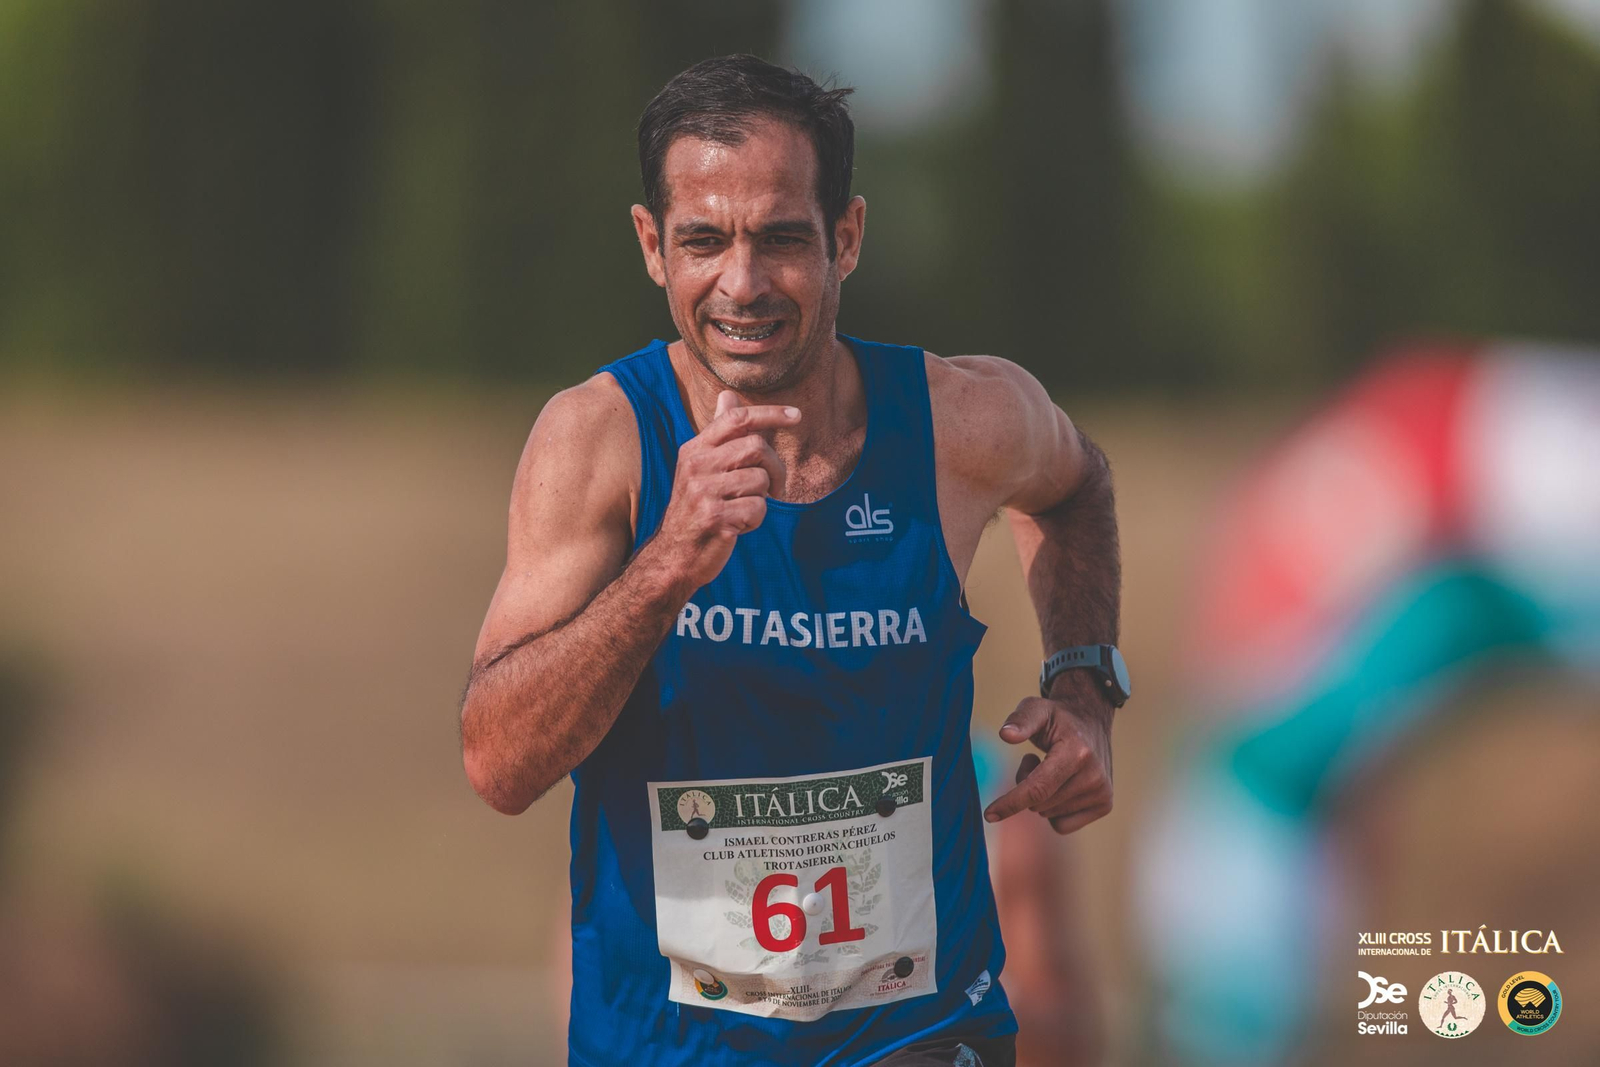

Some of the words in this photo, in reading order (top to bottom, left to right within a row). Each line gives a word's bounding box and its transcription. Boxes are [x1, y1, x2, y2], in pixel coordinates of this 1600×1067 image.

[676, 602, 928, 649] ROTASIERRA
[733, 785, 865, 819] ITÁLICA
[737, 817, 799, 826] INTERNATIONAL
[802, 815, 826, 823] CROSS
[828, 809, 865, 820] COUNTRY
[703, 852, 735, 861] CLUB
[737, 848, 805, 859] ATLETISMO
[806, 831, 896, 855] HORNACHUELOS
[724, 836, 769, 847] ISMAEL
[771, 830, 840, 846] CONTRERAS
[842, 823, 877, 837] PÉREZ
[763, 855, 844, 871] TROTASIERRA
[752, 866, 866, 953] 61
[767, 992, 820, 1002] INTERNACIONAL
[821, 990, 830, 998] DE
[781, 999, 820, 1008] NOVIEMBRE
